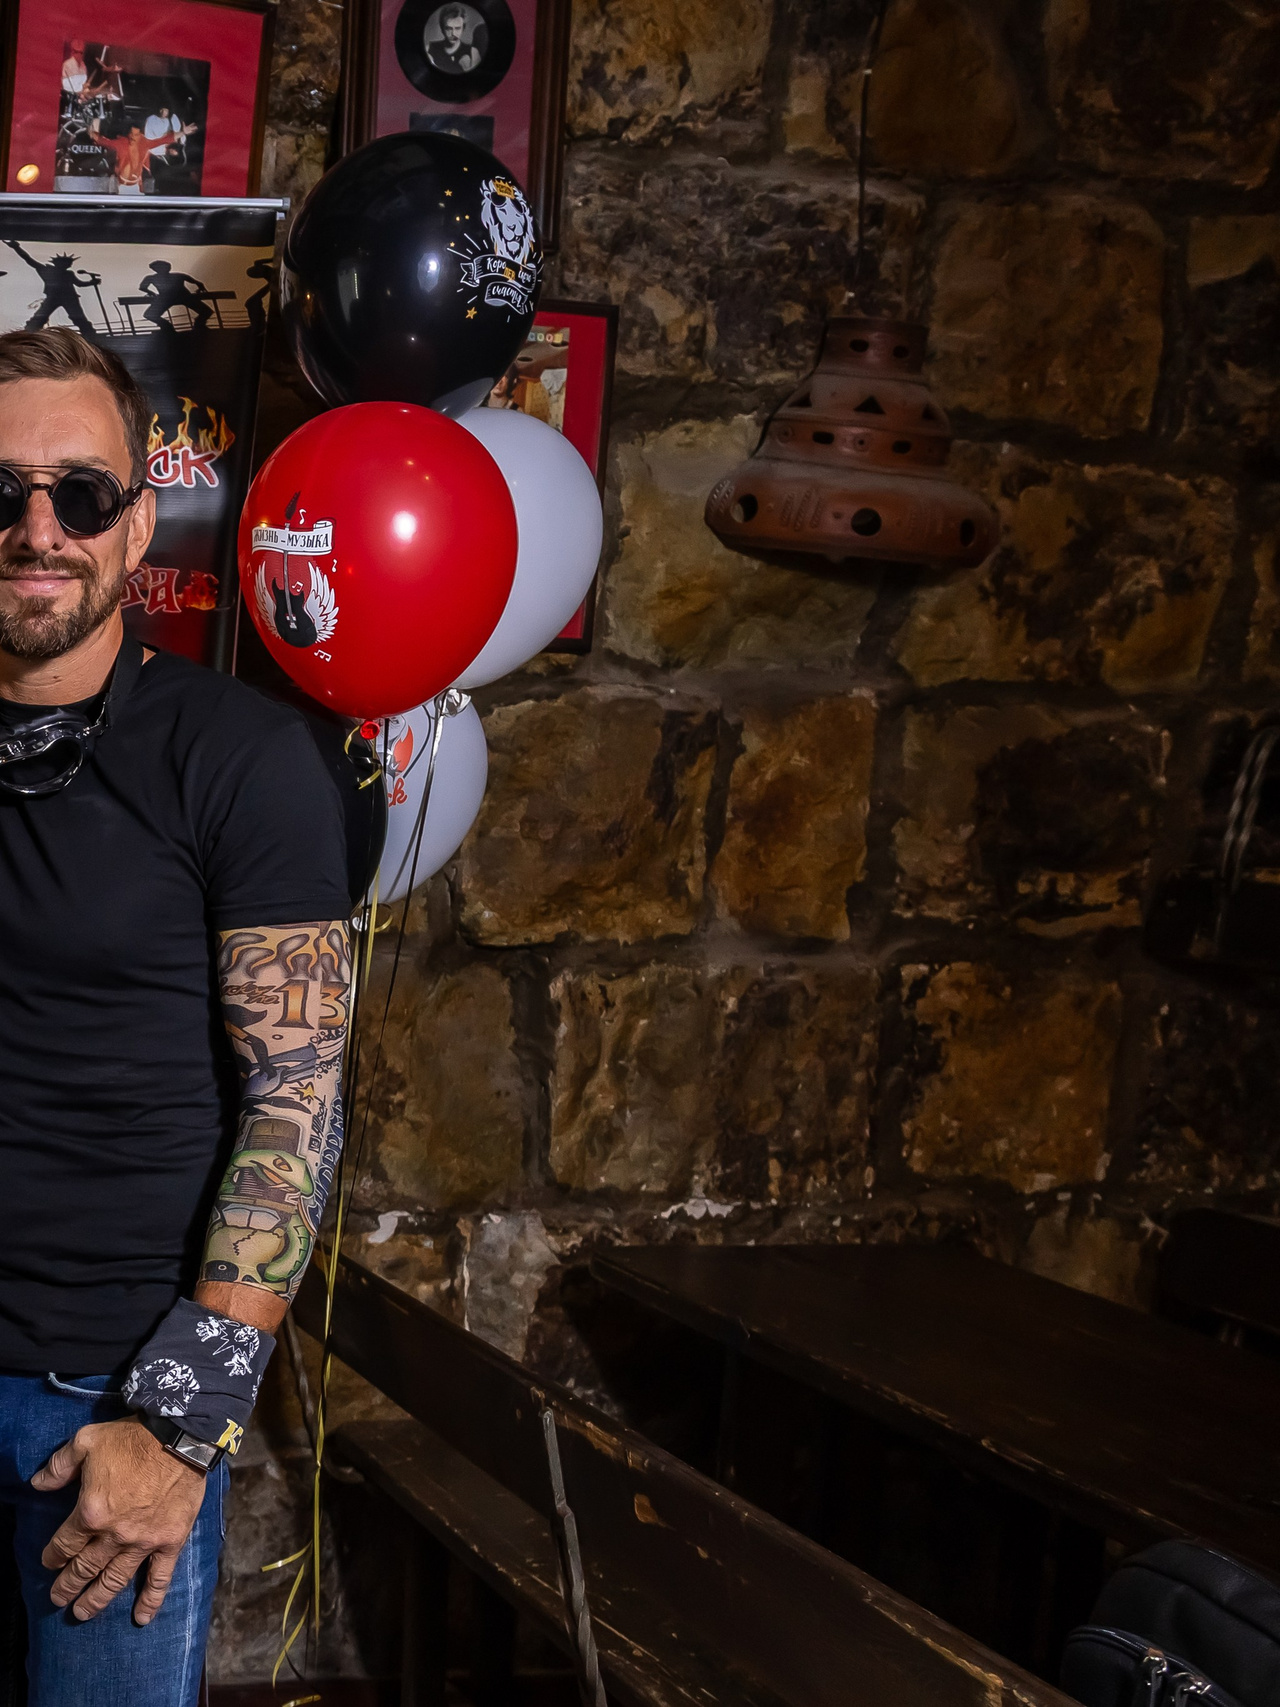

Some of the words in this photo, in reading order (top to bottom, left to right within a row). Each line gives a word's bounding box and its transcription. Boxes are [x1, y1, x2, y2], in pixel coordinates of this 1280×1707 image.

[71, 144, 102, 154] QUEEN
[254, 530, 279, 544] ЖИЗНЬ
[286, 532, 330, 549] МУЗЫКА
[272, 979, 348, 1029] 13
[306, 1072, 345, 1235] CHOPPER
